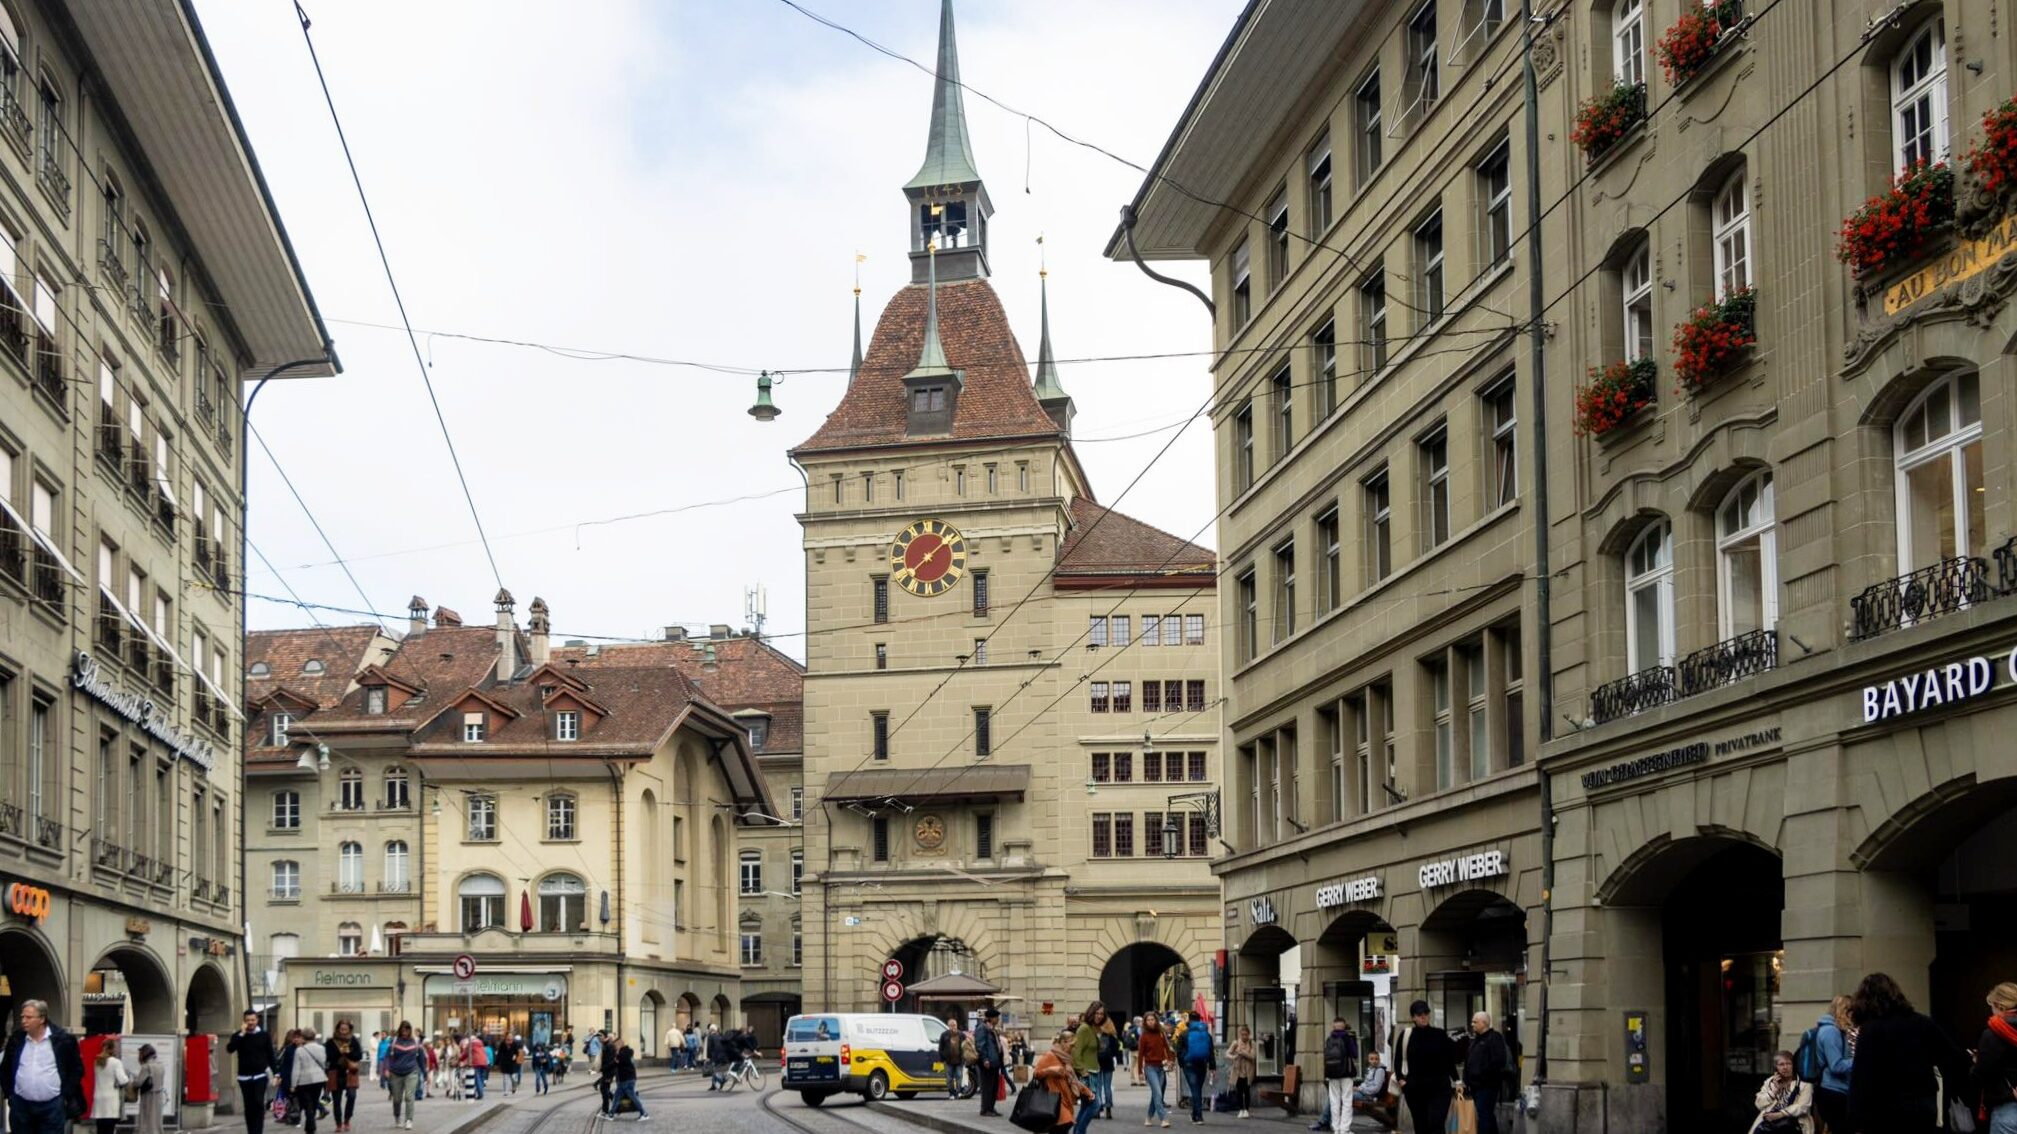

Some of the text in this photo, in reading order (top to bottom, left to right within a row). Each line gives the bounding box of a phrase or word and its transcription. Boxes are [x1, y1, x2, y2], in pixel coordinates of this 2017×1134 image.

[1896, 272, 1925, 309] AU
[1934, 241, 1976, 289] BON
[1863, 656, 1990, 723] BAYARD
[1715, 727, 1781, 756] PRIVATBANK
[1419, 850, 1502, 889] GERRY WEBER
[12, 882, 50, 925] coop
[1251, 895, 1274, 925] Salt.
[1316, 876, 1378, 908] GERRY WEBER
